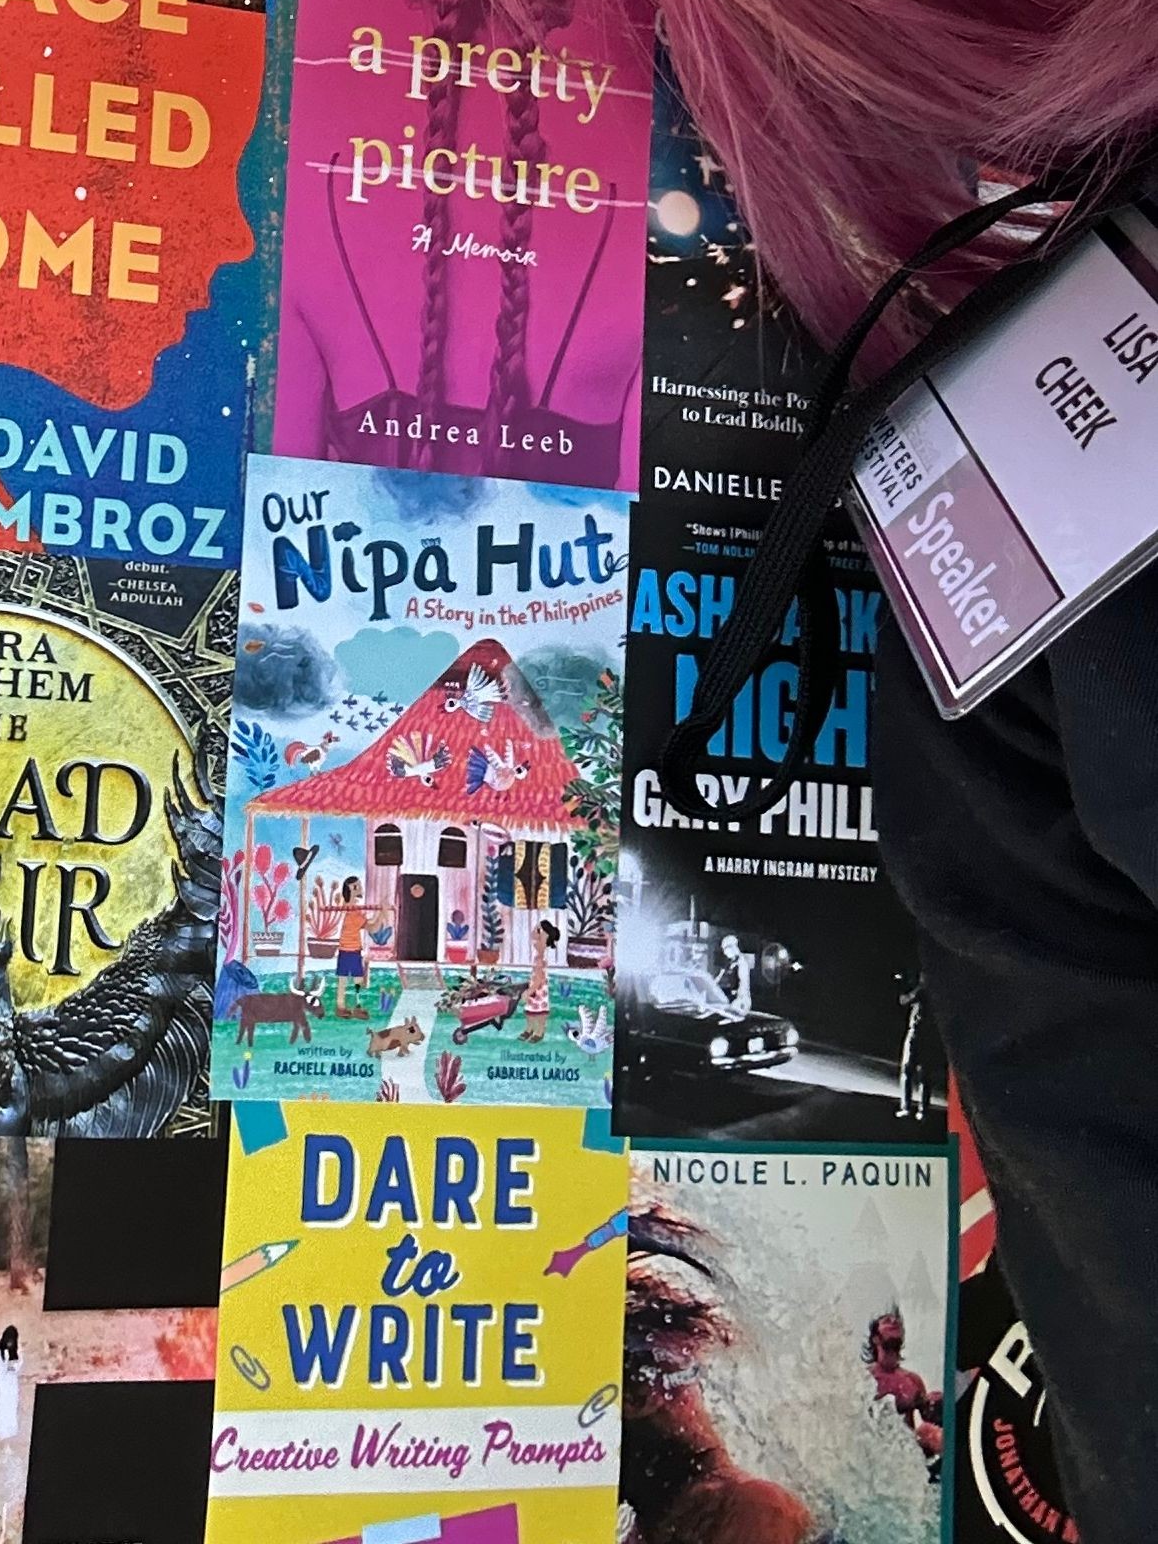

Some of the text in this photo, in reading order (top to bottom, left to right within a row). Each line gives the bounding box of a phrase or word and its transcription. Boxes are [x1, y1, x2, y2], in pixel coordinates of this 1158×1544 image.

[405, 32, 618, 125] pretty
[345, 124, 602, 215] picture
[651, 375, 750, 408] Harnessing
[704, 407, 747, 429] Lead
[1034, 355, 1118, 452] CHEEK
[358, 409, 575, 456] Andrea Leeb
[873, 415, 922, 491] WRITERS
[652, 465, 783, 502] DANIELLE
[108, 590, 185, 608] ABDULLAH
[272, 520, 458, 622] Nipa
[907, 491, 1012, 650] Speaker
[405, 587, 625, 631] A Story the Philippines
[630, 567, 736, 640] ASH
[716, 856, 879, 884] HARRY INGRAM MYSTERY
[273, 1061, 328, 1077] RACHELL
[487, 1064, 581, 1083] GABRIELA LARIOS
[300, 1132, 540, 1229] DARE
[652, 1157, 934, 1189] NICOLE L. PAQUIN
[380, 1233, 463, 1298] to
[281, 1303, 544, 1390] WRITE
[210, 1419, 608, 1479] Creative Writing Prompts
[993, 1417, 1062, 1534] JONATHAN
